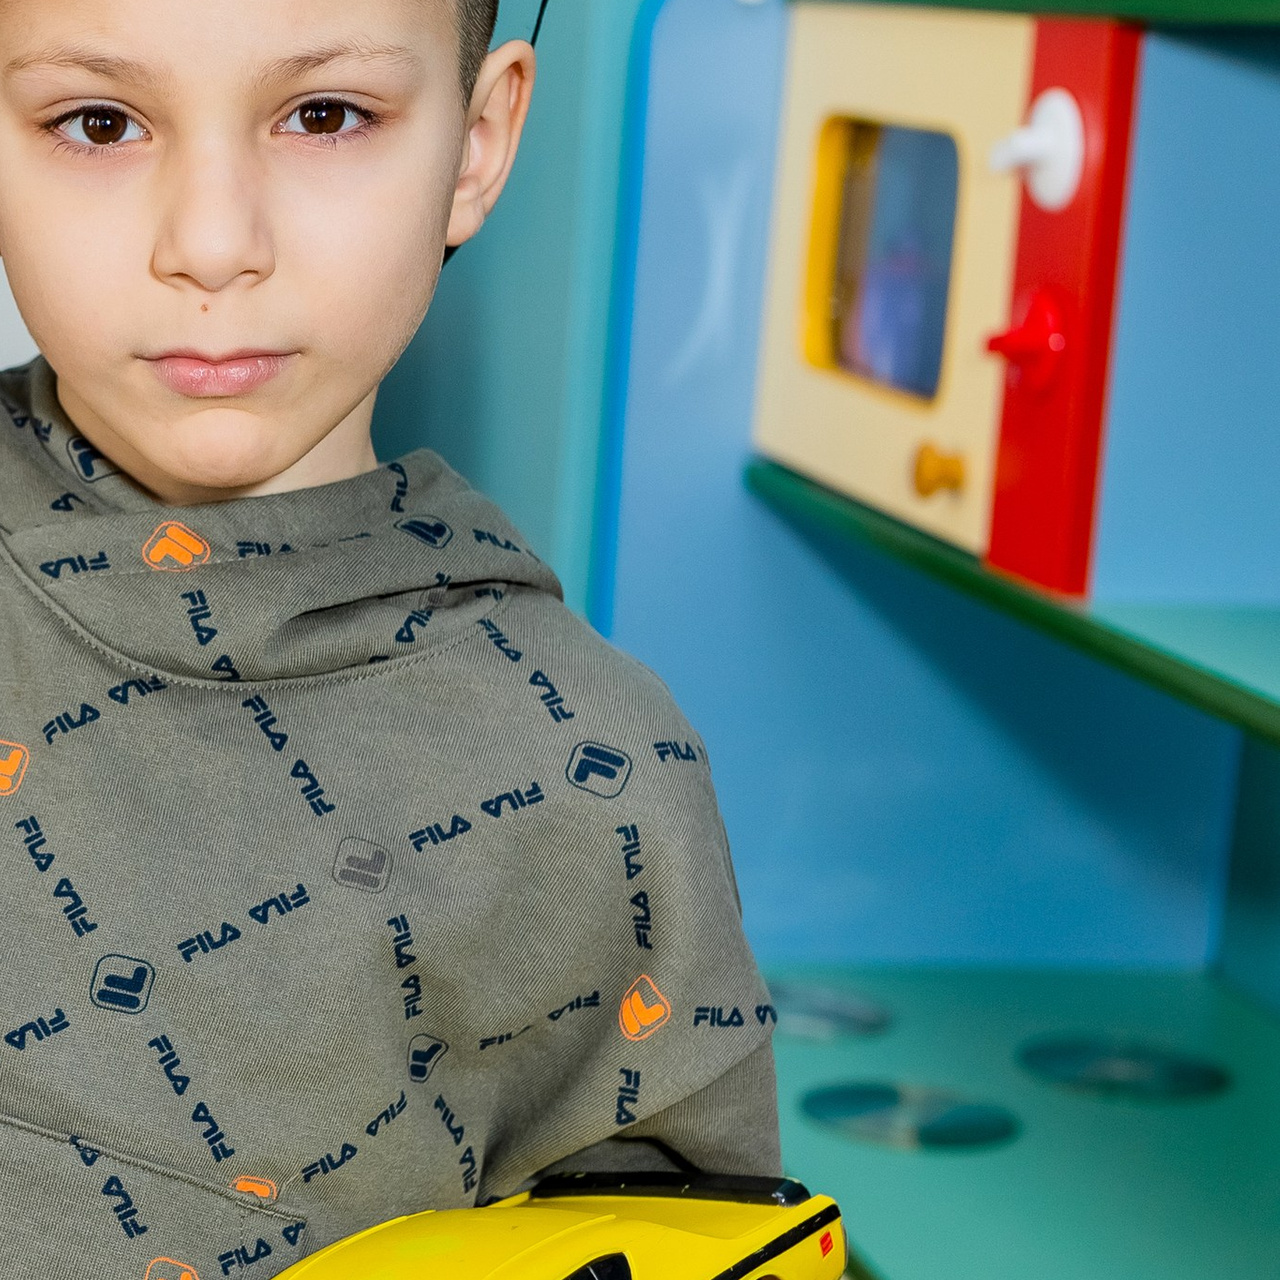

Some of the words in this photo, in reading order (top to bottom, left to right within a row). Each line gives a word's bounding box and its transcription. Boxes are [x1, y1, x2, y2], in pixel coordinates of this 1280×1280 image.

[40, 552, 112, 580] FILA
[181, 590, 219, 648] FILA
[108, 676, 168, 706] FILA
[529, 670, 576, 724] FILA
[43, 703, 102, 746] FILA
[242, 694, 290, 753] FILA
[654, 741, 696, 765] FILA
[291, 760, 337, 818] FILA
[481, 782, 546, 820] FILA
[15, 816, 57, 874] FILA
[409, 815, 473, 854] FILA
[616, 824, 645, 882] FILA
[54, 878, 99, 939] FILA
[249, 884, 312, 926] FILA
[631, 891, 653, 951] FILA
[178, 922, 243, 965] FILA
[387, 915, 417, 969] FILA
[5, 1009, 72, 1052] FILA
[694, 1007, 746, 1029] FILA
[148, 1035, 192, 1097] FILA
[192, 1102, 237, 1164] FILA
[434, 1094, 465, 1147] FILA
[304, 1143, 359, 1184] FILA
[102, 1176, 150, 1240] FILA
[218, 1239, 274, 1277] FILA
